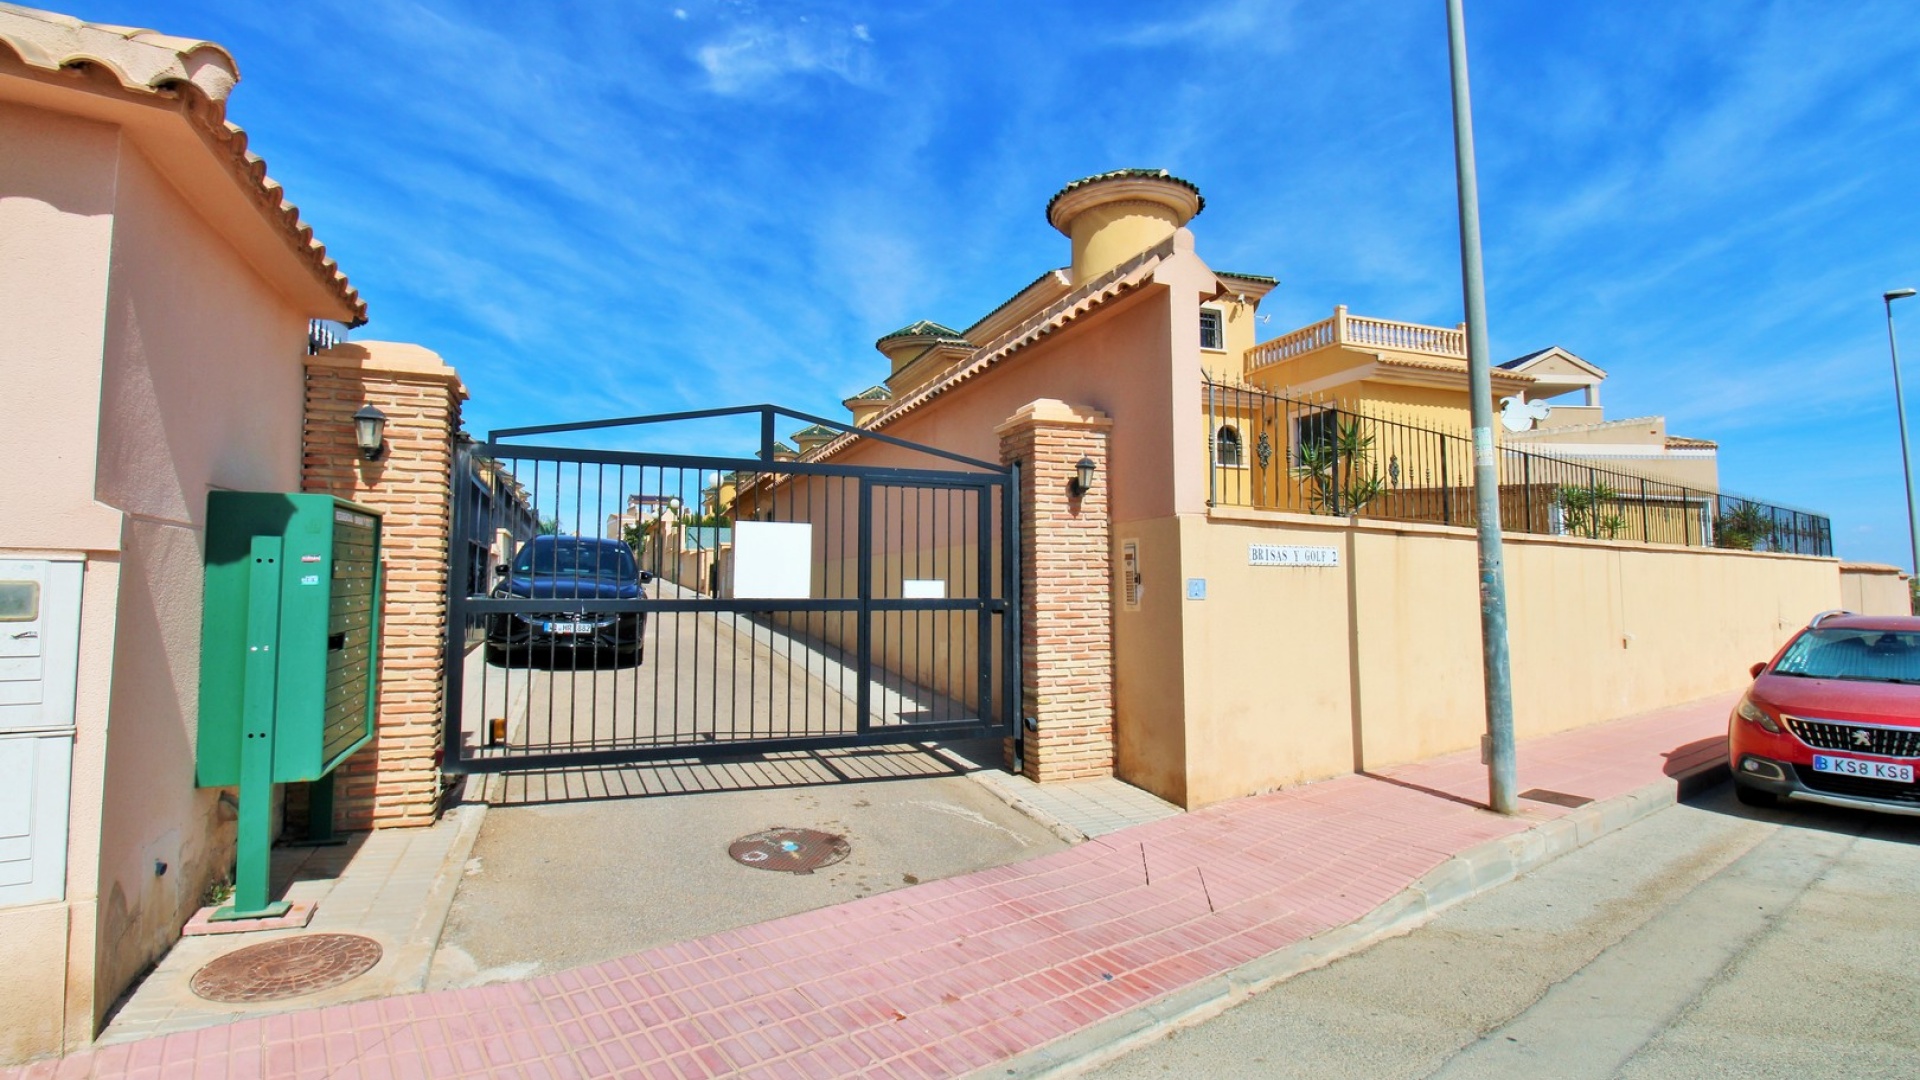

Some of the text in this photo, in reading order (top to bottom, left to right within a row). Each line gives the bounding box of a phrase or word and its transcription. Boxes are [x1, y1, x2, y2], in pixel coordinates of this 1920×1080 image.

[1252, 548, 1337, 562] BRISAS Y GOLF 2
[1834, 759, 1868, 775] KS8
[1875, 764, 1909, 780] KS8
